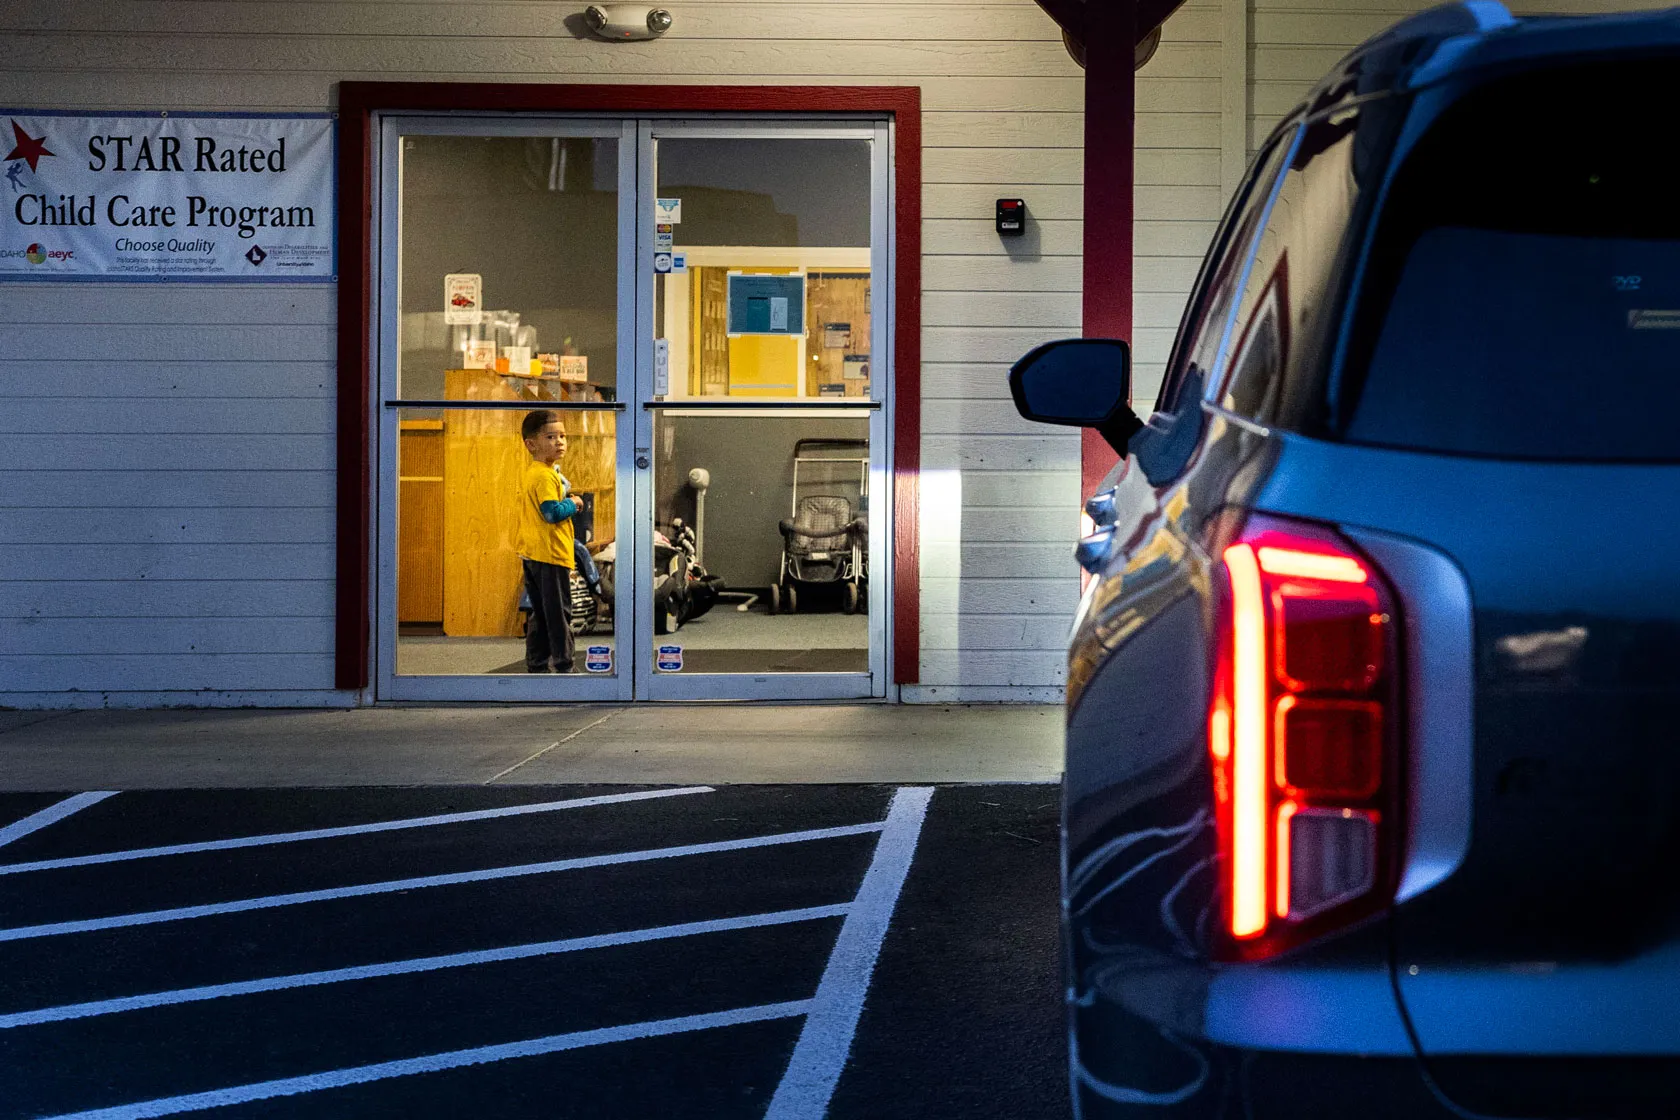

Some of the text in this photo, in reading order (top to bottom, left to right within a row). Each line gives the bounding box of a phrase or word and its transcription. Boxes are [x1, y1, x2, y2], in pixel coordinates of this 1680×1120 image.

[88, 134, 287, 173] STAR Rated
[15, 194, 316, 239] Child Care Program
[0, 249, 74, 261] DAHO aeyc
[115, 238, 215, 255] Choose Quality
[656, 344, 667, 389] PULL
